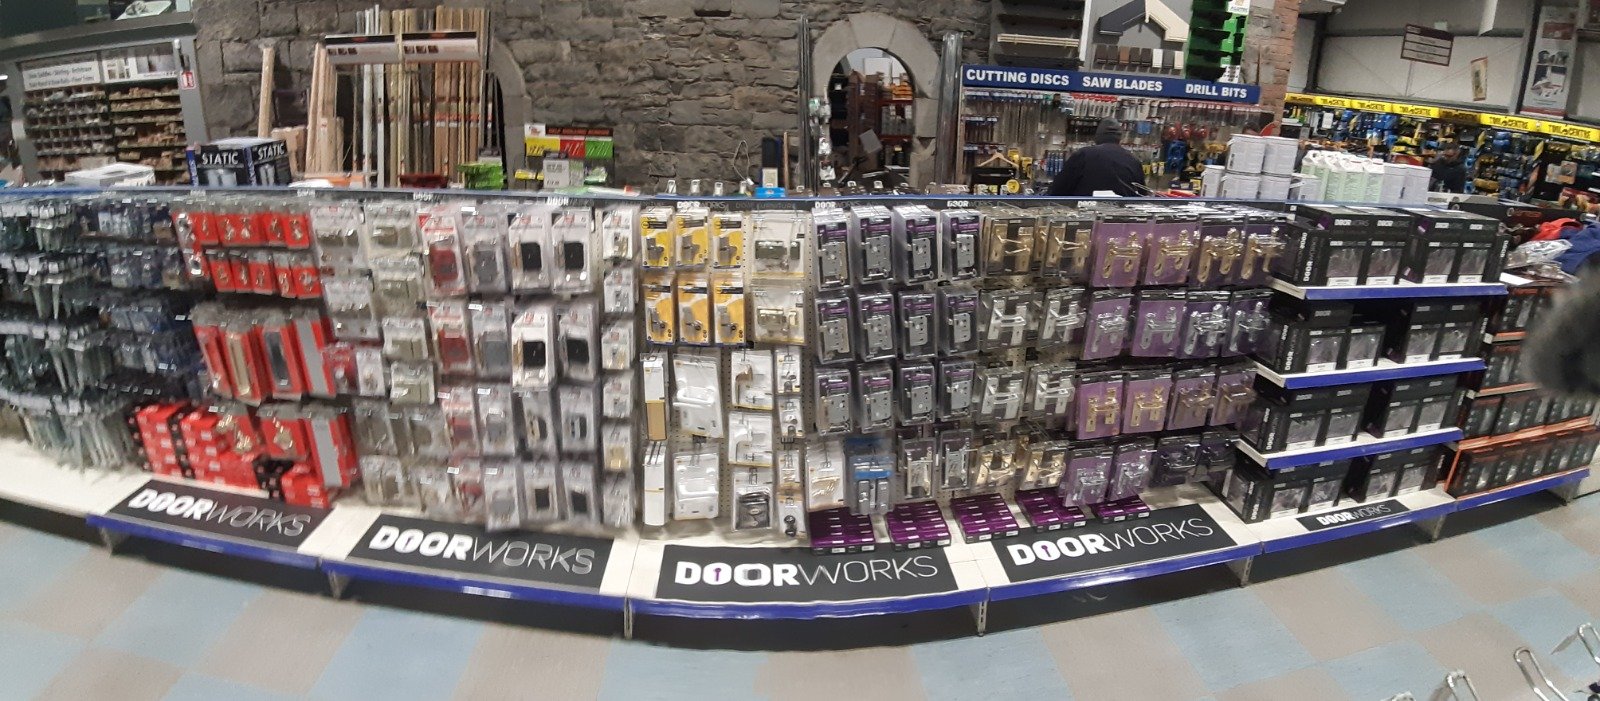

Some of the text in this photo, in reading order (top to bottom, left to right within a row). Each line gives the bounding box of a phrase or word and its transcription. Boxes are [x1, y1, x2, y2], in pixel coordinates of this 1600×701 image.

[966, 68, 1070, 86] CUTTING DISCS
[1082, 76, 1163, 92] SAW BLADES
[1185, 83, 1247, 98] DRILL BITS
[201, 151, 239, 166] STATIC
[257, 142, 285, 160] STATIC
[128, 488, 310, 537] DOORWORKS
[1316, 504, 1392, 526] DOORWORKS
[368, 524, 595, 575] DOORWORKS
[1006, 518, 1214, 567] DOORWORKS
[675, 555, 938, 587] DOORWORKS
